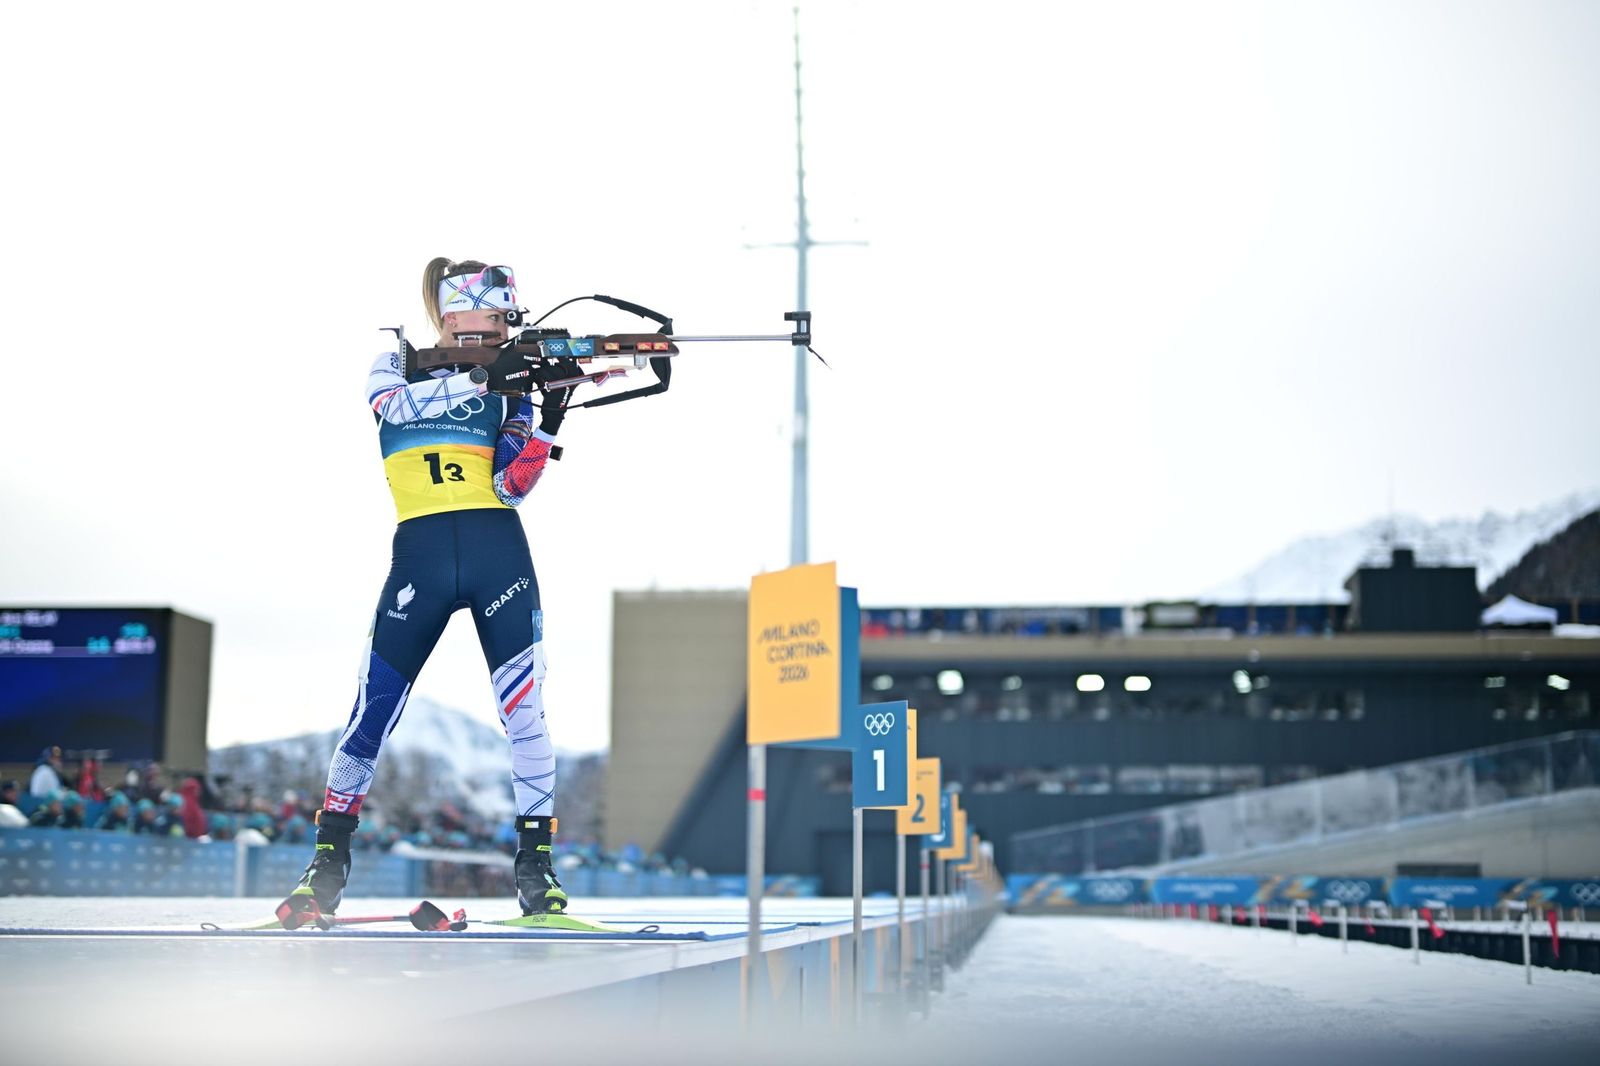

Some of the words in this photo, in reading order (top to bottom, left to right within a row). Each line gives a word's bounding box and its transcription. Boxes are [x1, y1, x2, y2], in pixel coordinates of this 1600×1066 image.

[402, 423, 435, 431] MILANO
[435, 423, 471, 433] CORTINA
[472, 428, 488, 437] 2026
[484, 582, 522, 617] CRAFT
[386, 609, 409, 621] FRANCE
[756, 619, 820, 645] MILANO
[767, 639, 832, 664] CORTINA
[873, 749, 886, 792] 1
[911, 793, 926, 823] 2
